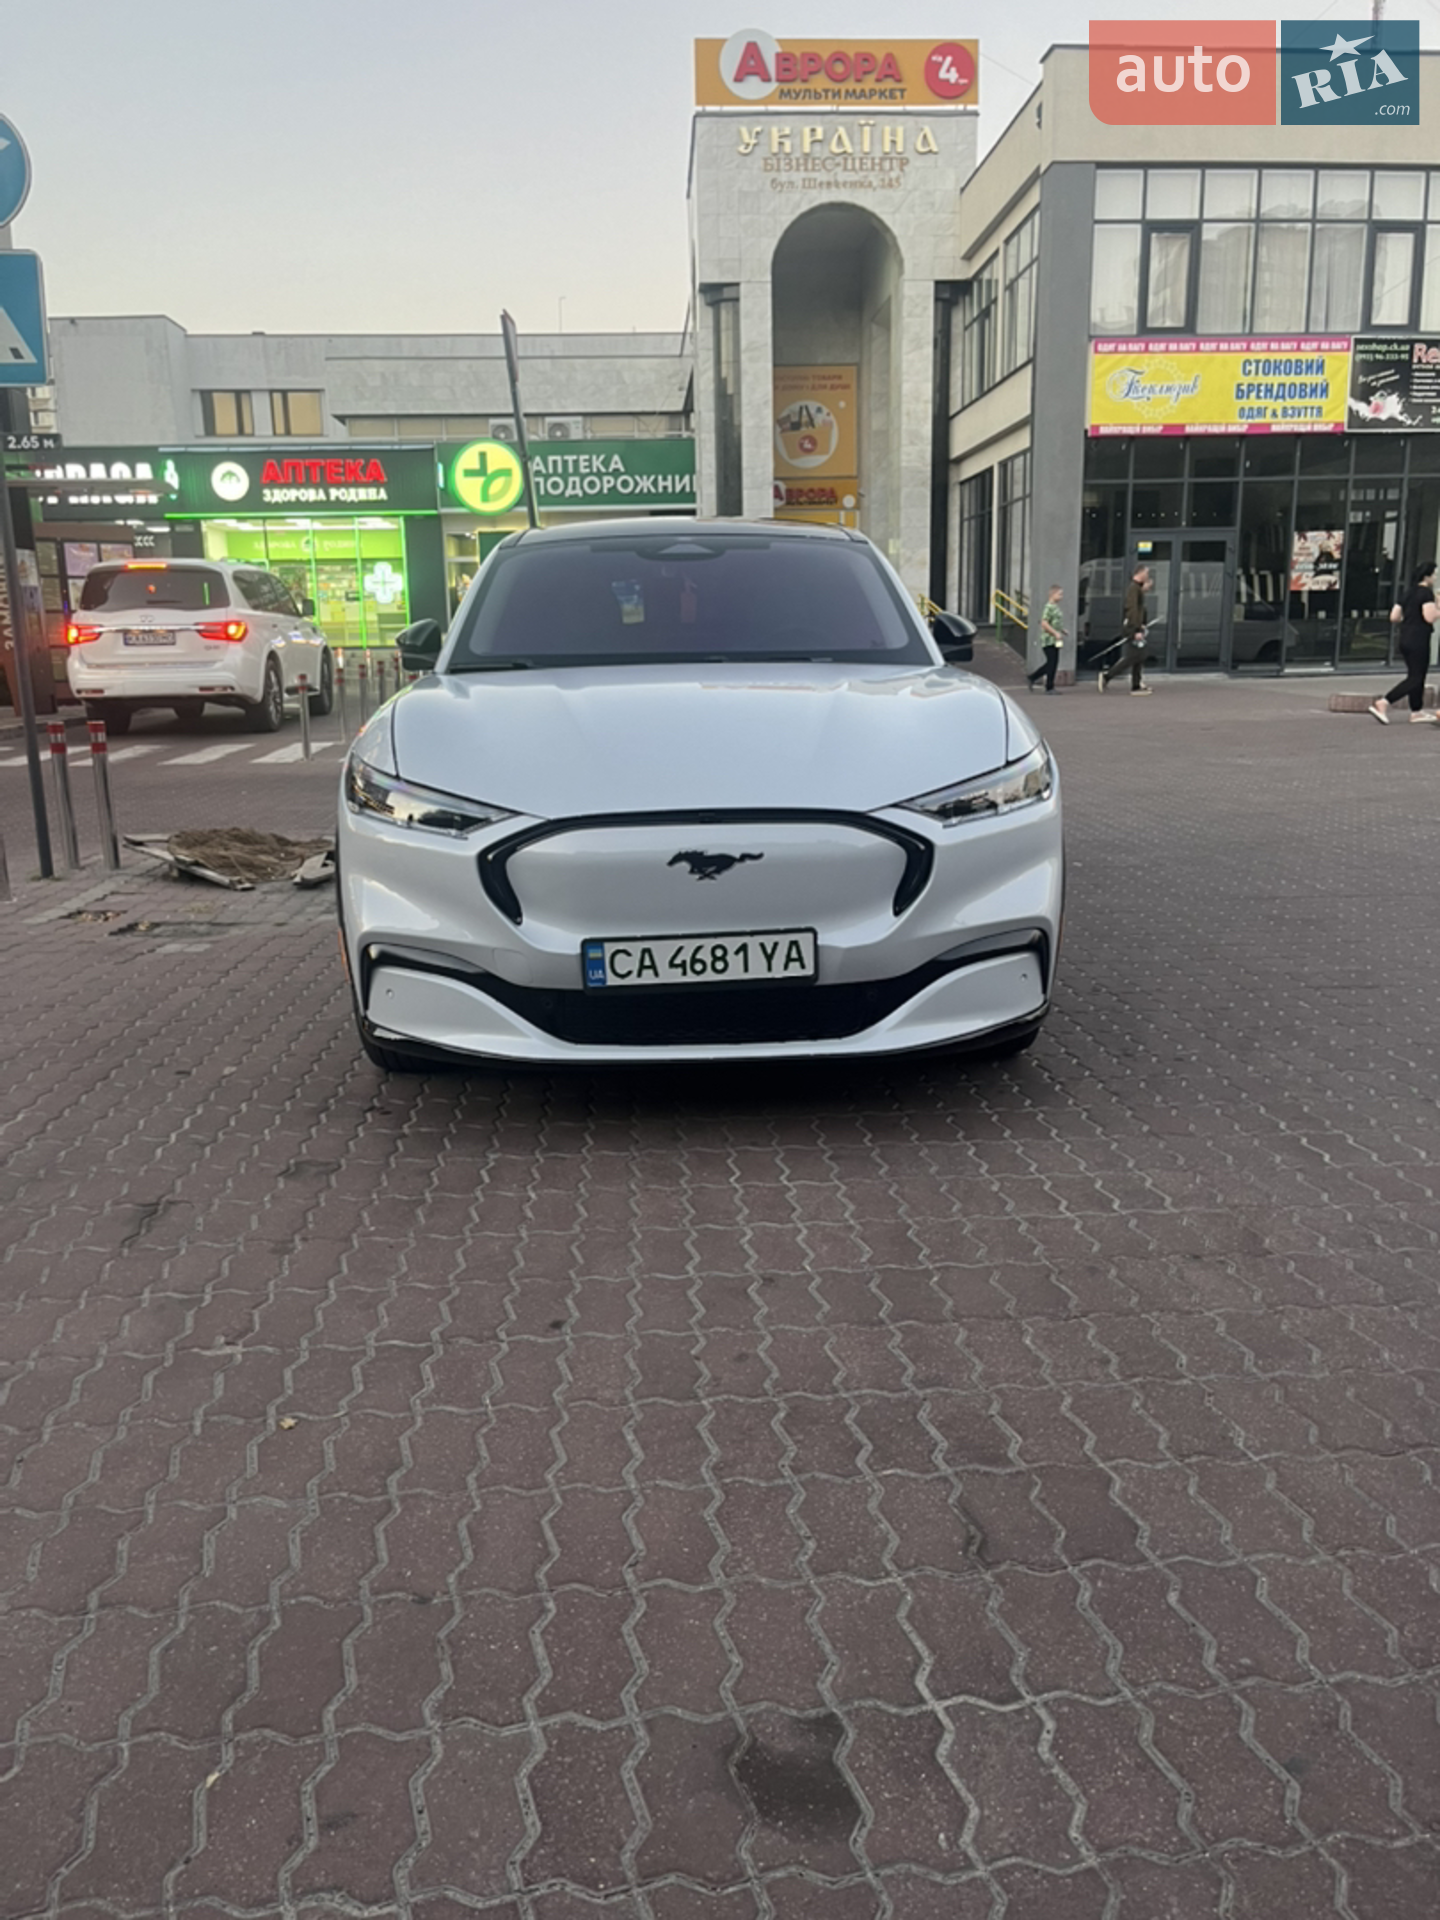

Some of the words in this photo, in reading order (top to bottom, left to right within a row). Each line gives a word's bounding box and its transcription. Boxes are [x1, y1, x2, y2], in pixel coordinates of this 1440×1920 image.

[733, 41, 903, 83] АВРОРА
[938, 55, 959, 84] 4
[737, 120, 939, 156] УКРАЇНА
[762, 156, 910, 174] БІЗНЕС-ЦЕНТР
[770, 177, 798, 193] бул.
[1413, 343, 1440, 363] Re
[1241, 356, 1325, 376] СТОКОВИЙ
[1235, 380, 1329, 402] БРЕНДОВИЙ
[1238, 406, 1268, 420] ОДЯГ
[7, 436, 40, 449] 2.65
[260, 459, 388, 484] АПТЕКА
[531, 454, 625, 474] АПТЕКА
[262, 488, 327, 503] ЗДОРОВА
[329, 488, 388, 502] РОДИНА
[534, 474, 697, 498] ПОДОРОЖНИ
[609, 947, 659, 979] CA
[668, 942, 750, 977] 4681
[759, 940, 806, 973] YA
